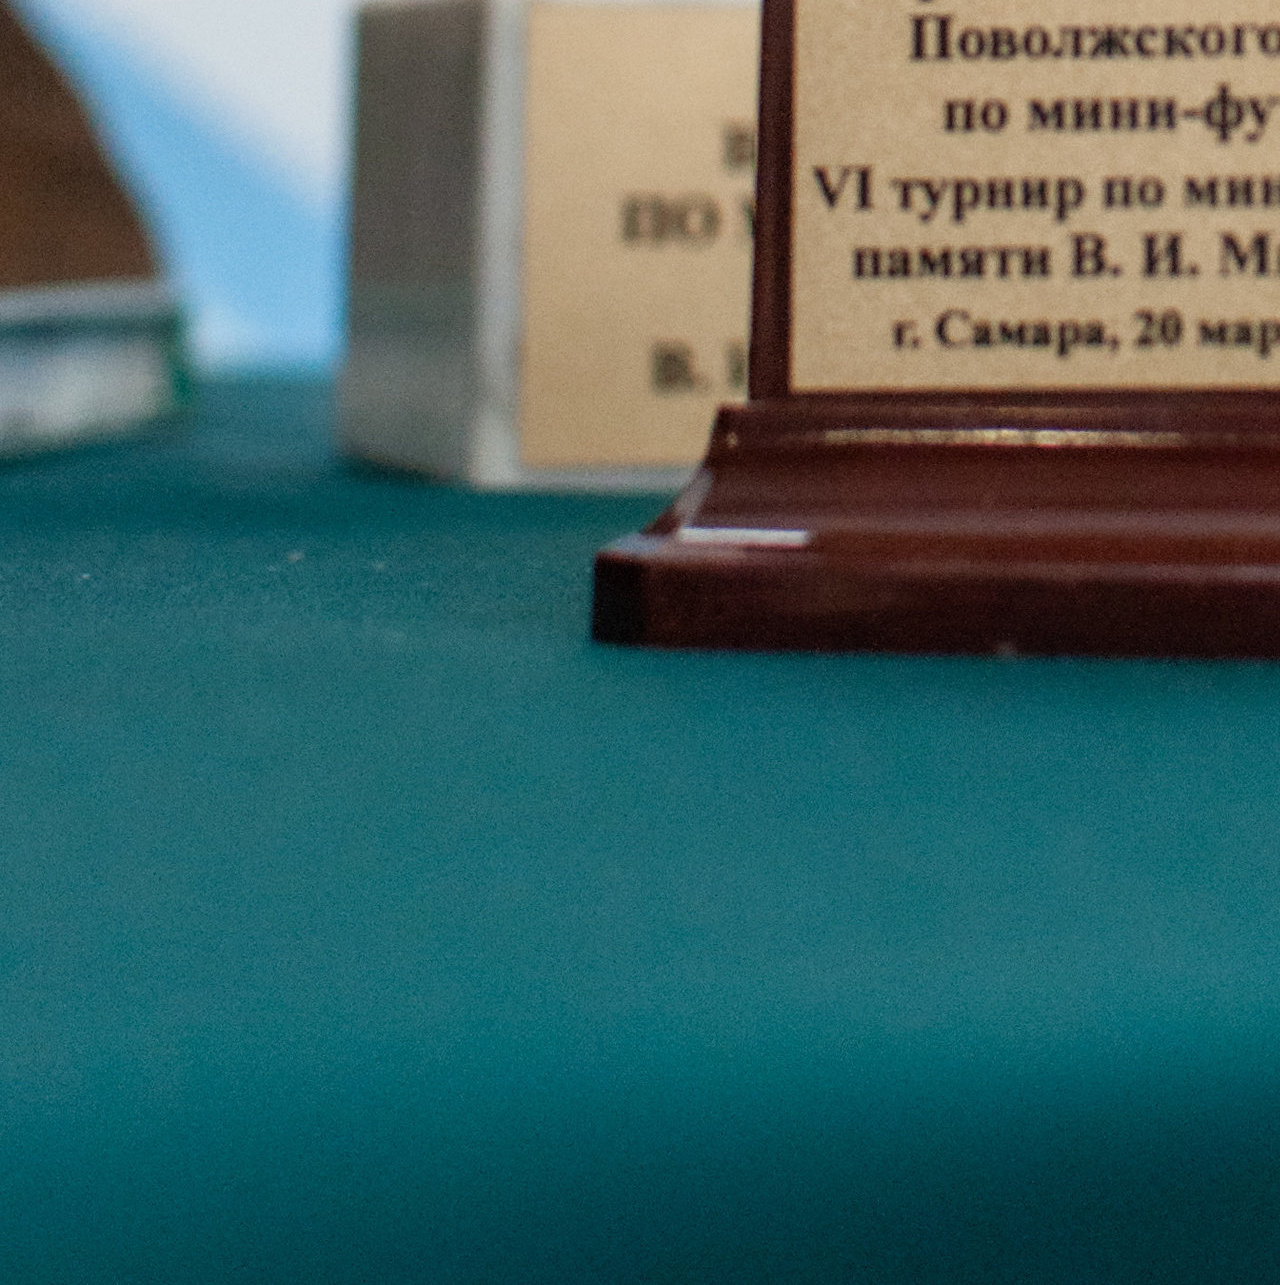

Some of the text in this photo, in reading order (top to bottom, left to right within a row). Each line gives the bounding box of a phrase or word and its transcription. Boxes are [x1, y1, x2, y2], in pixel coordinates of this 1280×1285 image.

[944, 99, 1009, 133] по
[813, 166, 873, 211] VI
[892, 177, 1086, 224] турнир
[1102, 176, 1166, 209] по
[853, 247, 1051, 280] памяти
[1071, 233, 1121, 279] В.
[1142, 233, 1199, 278] И.
[892, 321, 920, 350] г.
[934, 310, 1120, 359] Самара,
[1134, 309, 1185, 349] 20
